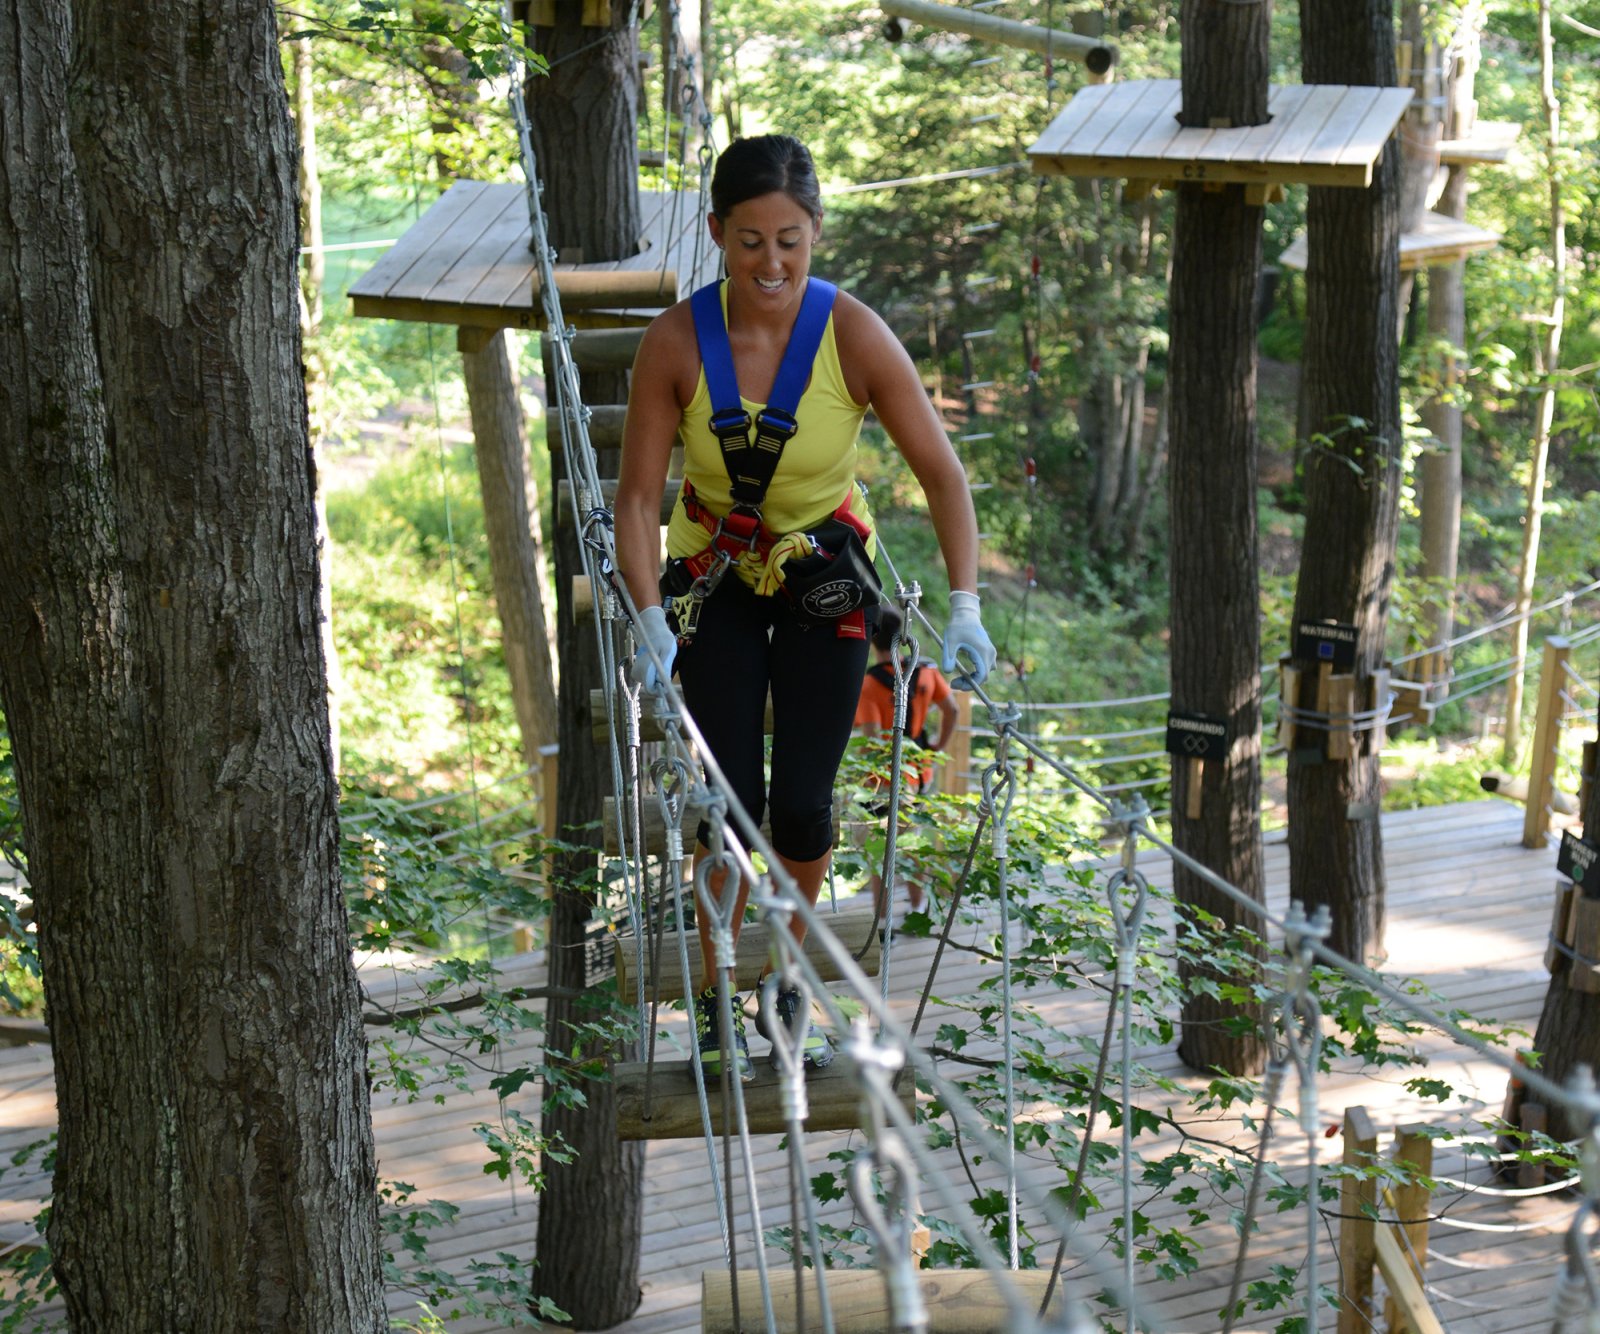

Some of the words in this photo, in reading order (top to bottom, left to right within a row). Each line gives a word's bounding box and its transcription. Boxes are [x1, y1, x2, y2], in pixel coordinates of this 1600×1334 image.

[1300, 624, 1354, 642] WATERFALL
[1169, 717, 1225, 736] COMMANDO
[1566, 835, 1597, 864] FOREST
[1571, 850, 1589, 870] RUN
